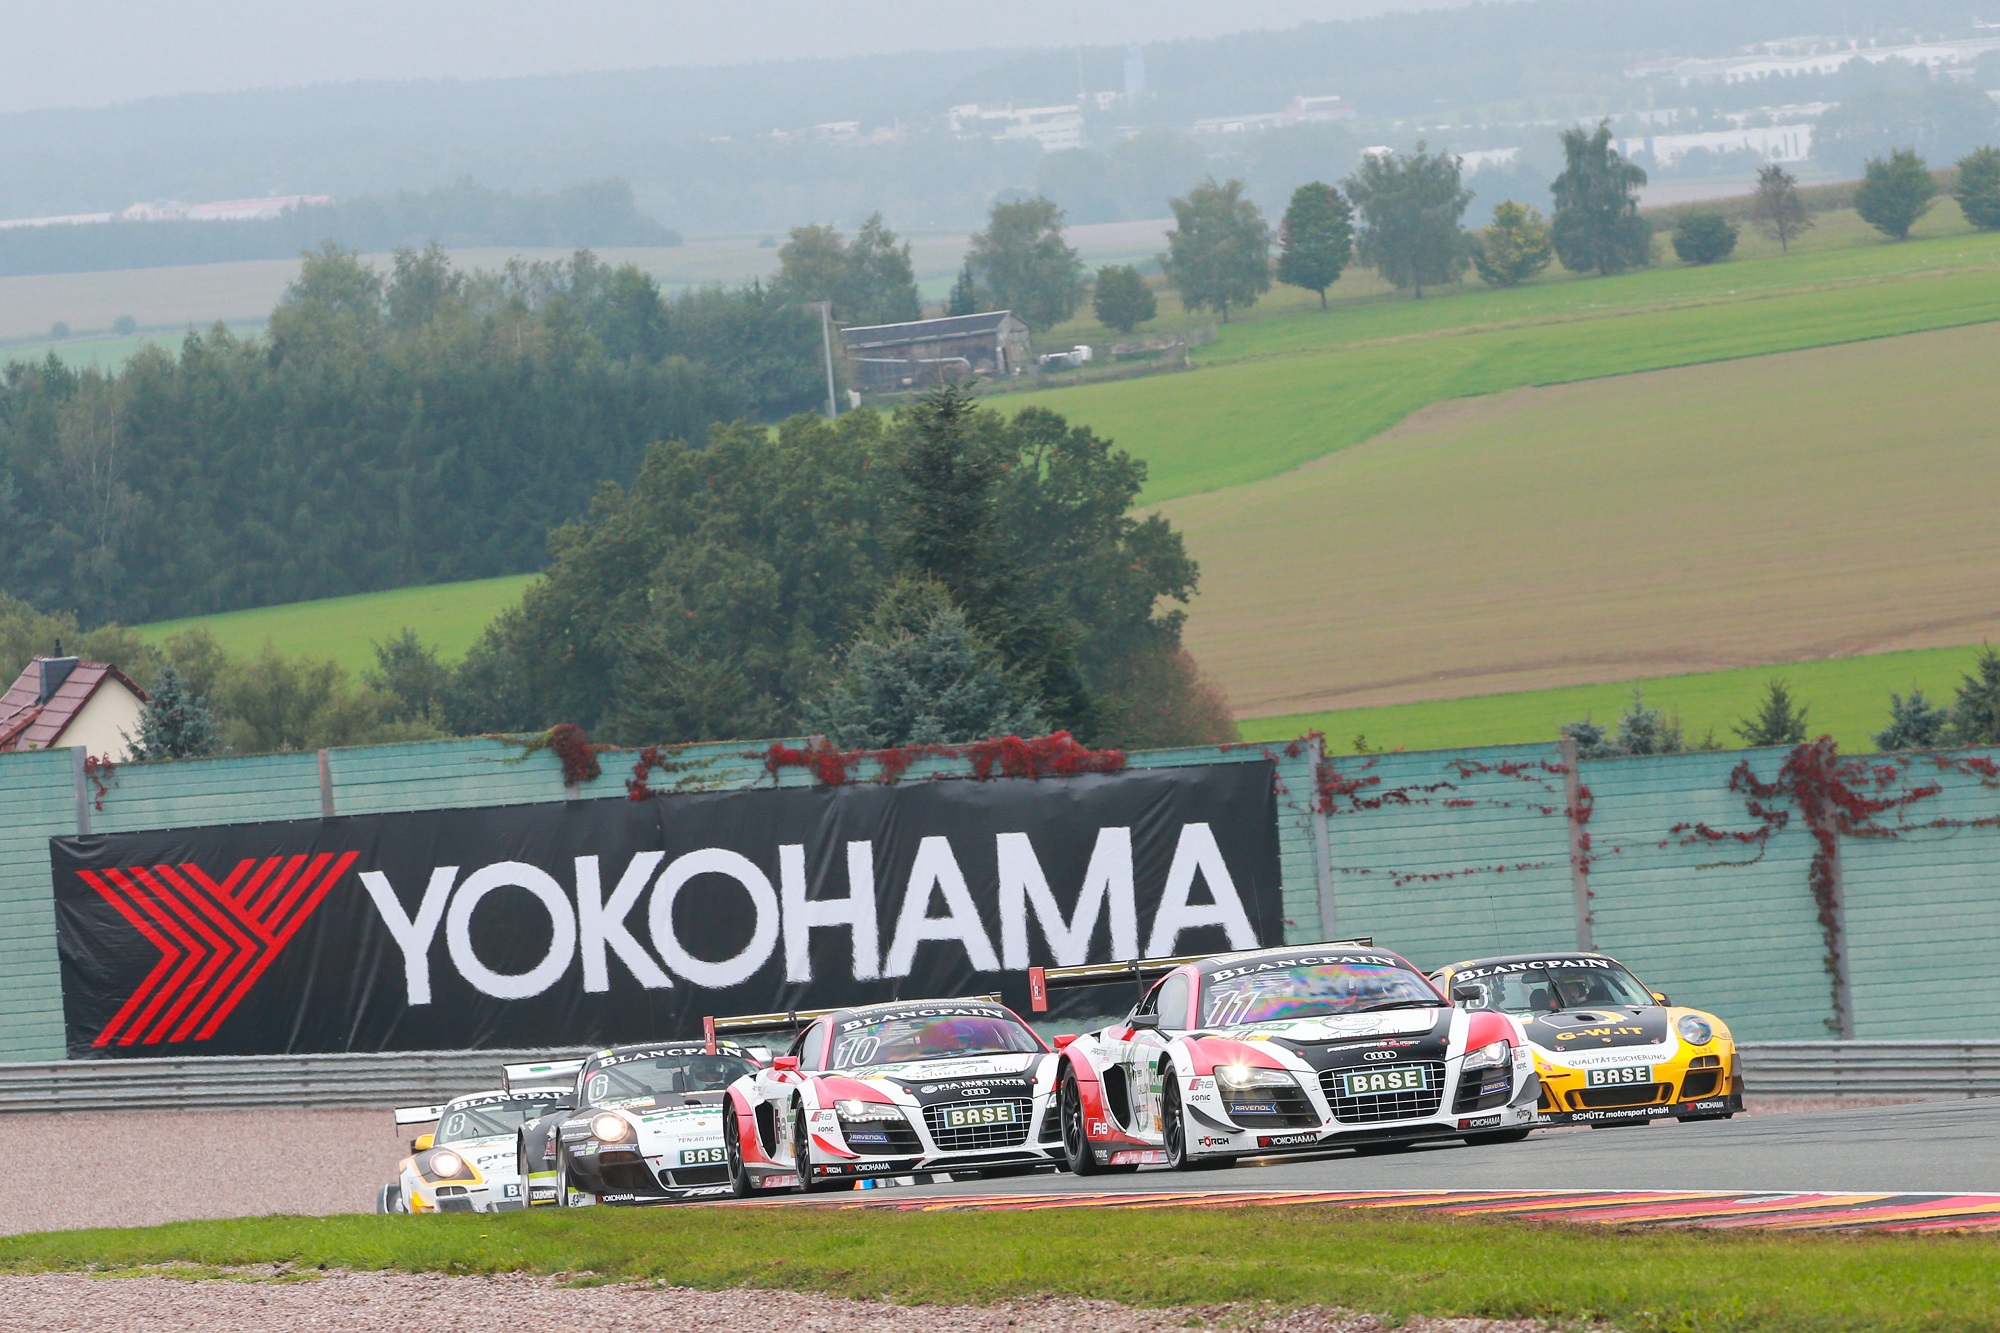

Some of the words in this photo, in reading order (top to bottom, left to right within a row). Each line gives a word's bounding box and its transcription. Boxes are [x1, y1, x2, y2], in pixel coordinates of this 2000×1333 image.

[358, 821, 1263, 1006] YOKOHAMA
[1209, 955, 1397, 983] BLANCPAIN
[1454, 959, 1610, 984] BLANCPAIN
[1204, 989, 1262, 1028] 11
[840, 1007, 1003, 1033] BLANCPAIN
[1555, 1026, 1644, 1041] G-W.IT
[834, 1035, 882, 1070] 10
[1567, 1053, 1667, 1067] QUALITÄTSSICHERUNG
[1353, 1070, 1419, 1093] BASE
[1592, 1066, 1647, 1085] BASE
[587, 1074, 609, 1101] 6
[1194, 1079, 1214, 1090] R8
[1234, 1104, 1271, 1112] RAVENOL
[1695, 1101, 1725, 1110] YOKOHAMA
[816, 1111, 833, 1122] R8
[951, 1106, 1009, 1126] BASE
[1571, 1110, 1606, 1121] SCHÜTZ
[1605, 1108, 1647, 1119] motorsport
[1647, 1106, 1670, 1115] GmbH
[446, 1113, 467, 1137] 8
[1092, 1122, 1109, 1135] R8
[1469, 1117, 1500, 1127] YOKOHAMA
[1270, 1134, 1317, 1145] YOKOHAMA
[854, 1162, 891, 1172] YOKOHAMA
[506, 1185, 521, 1199] B
[602, 1193, 635, 1203] YOKOHAMA
